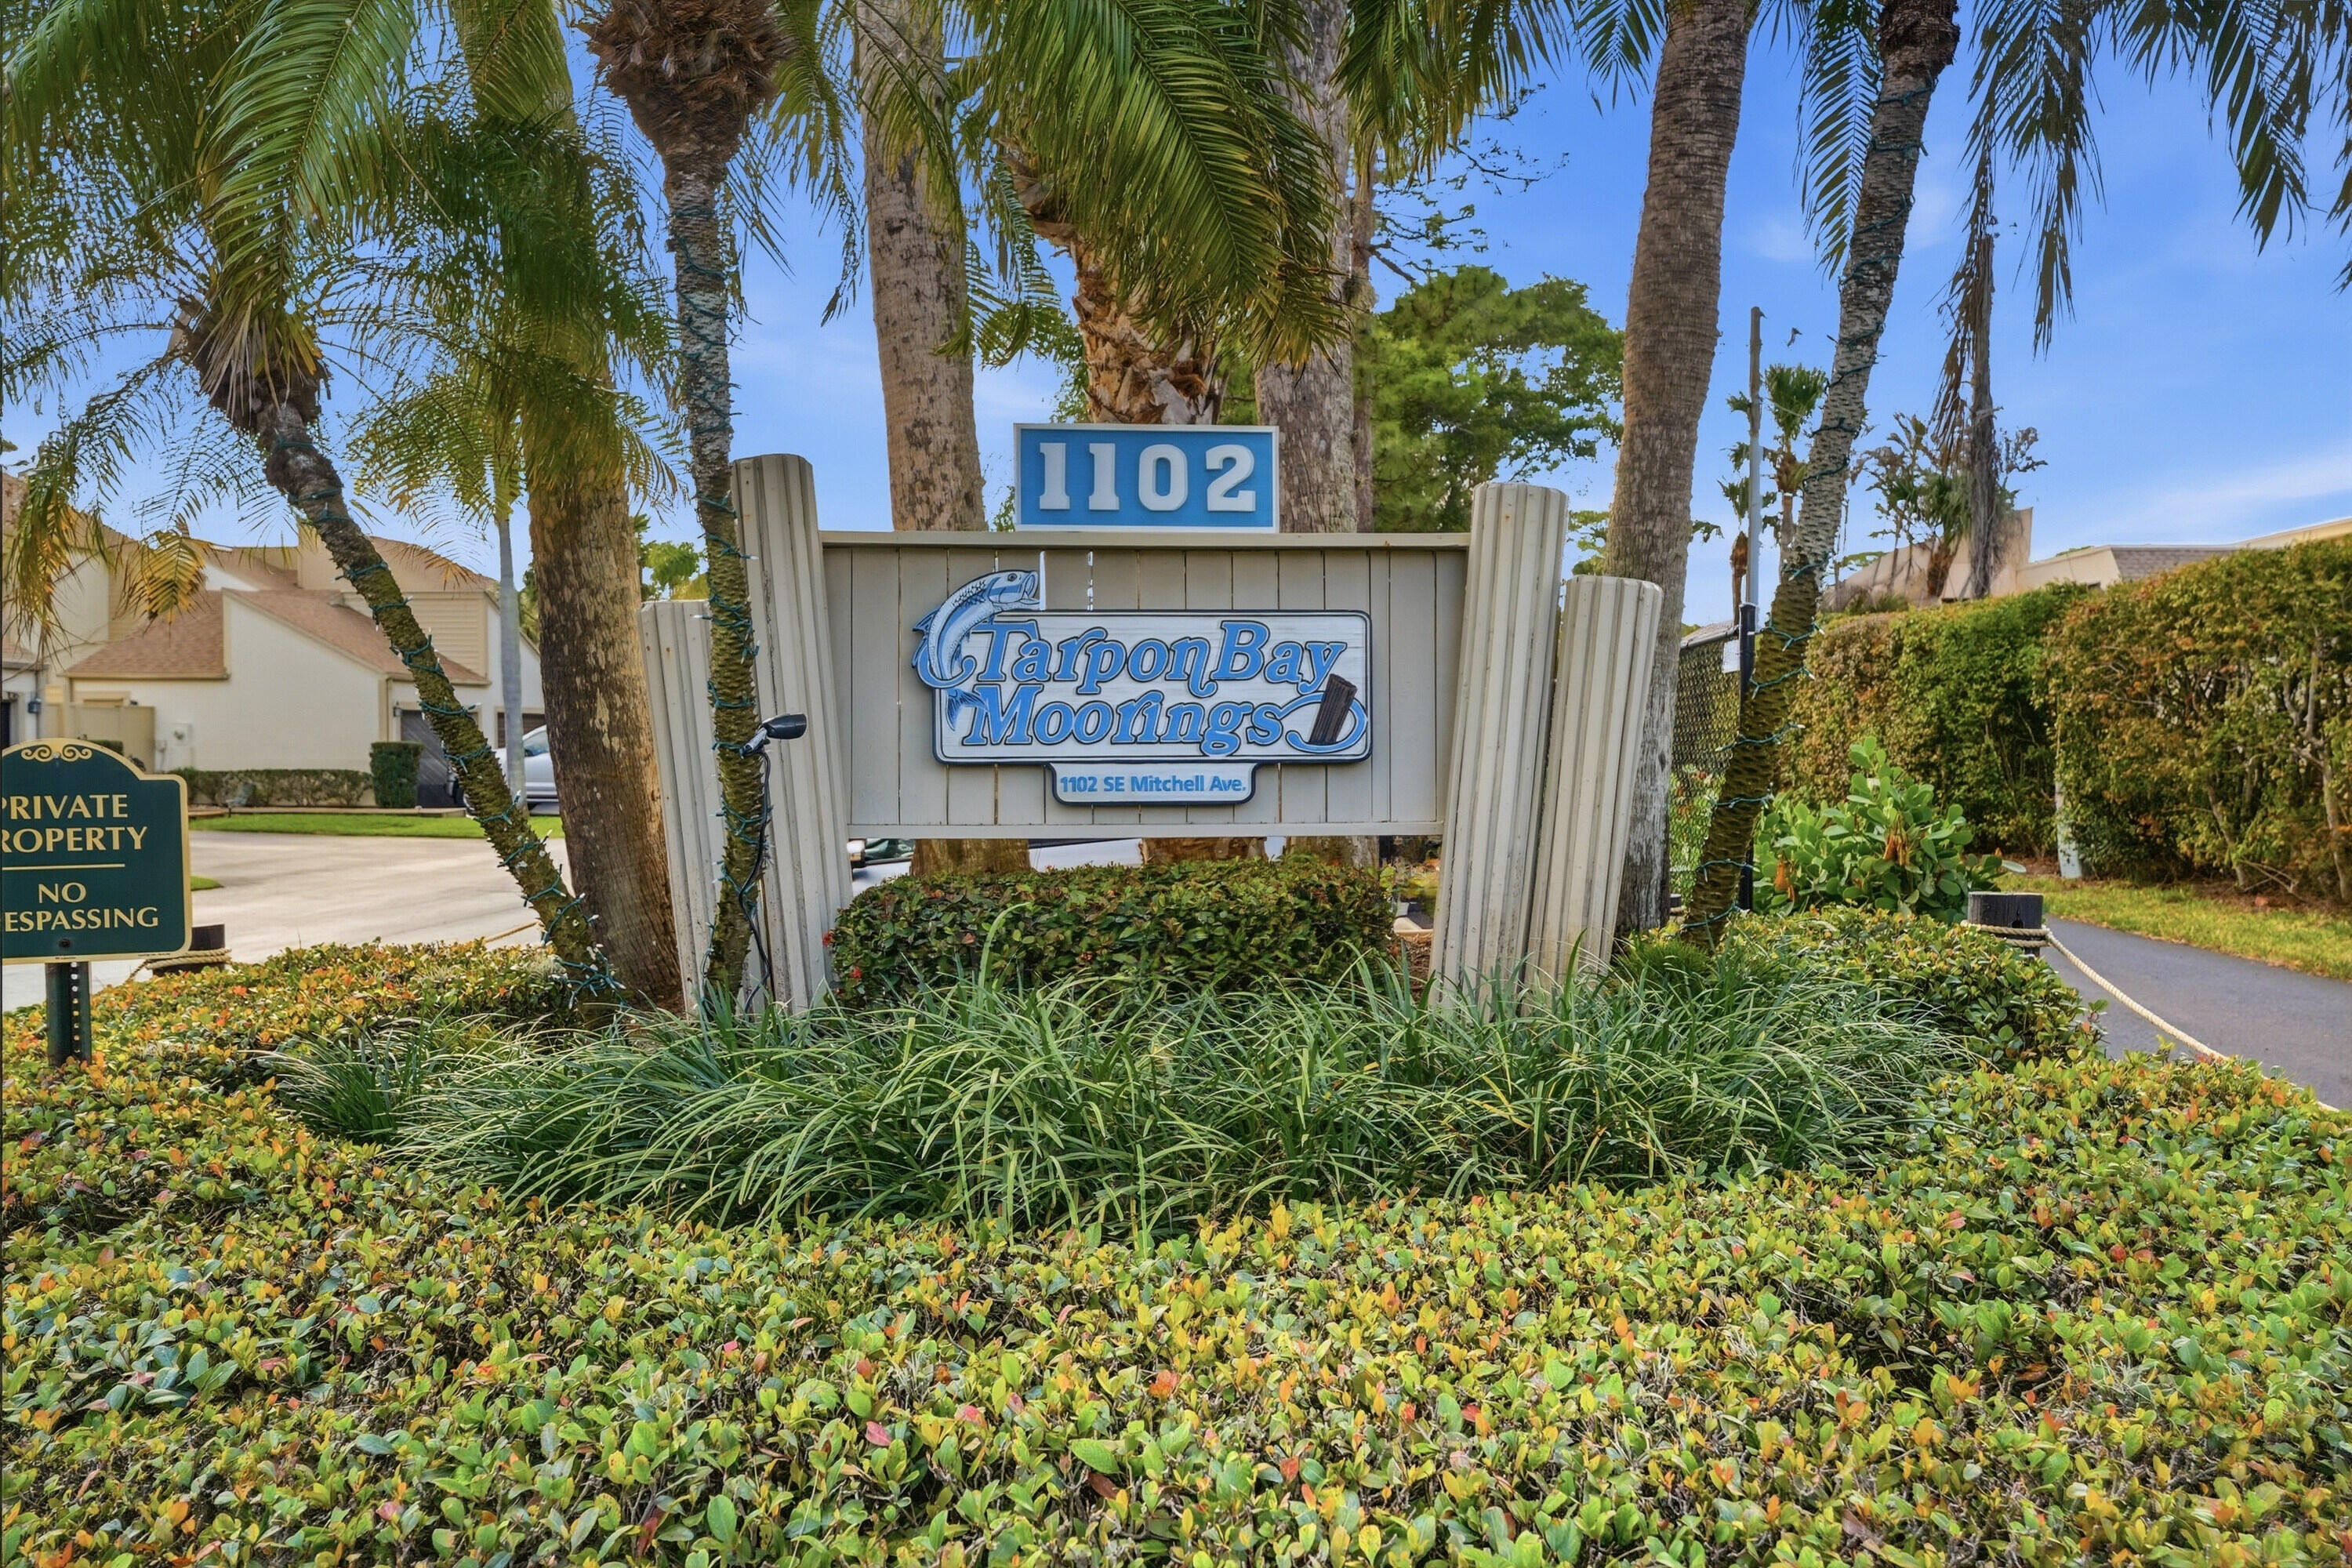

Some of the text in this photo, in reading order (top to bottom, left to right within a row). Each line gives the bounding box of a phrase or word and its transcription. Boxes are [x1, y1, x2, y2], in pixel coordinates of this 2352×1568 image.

[1040, 443, 1257, 512] 1102
[916, 619, 1348, 697] Tarpon Bay
[962, 683, 1368, 757] Moorings
[2, 794, 128, 820] RIVATE
[1060, 775, 1247, 793] 1102 SE Mitchell Ave.
[38, 882, 87, 904] NO
